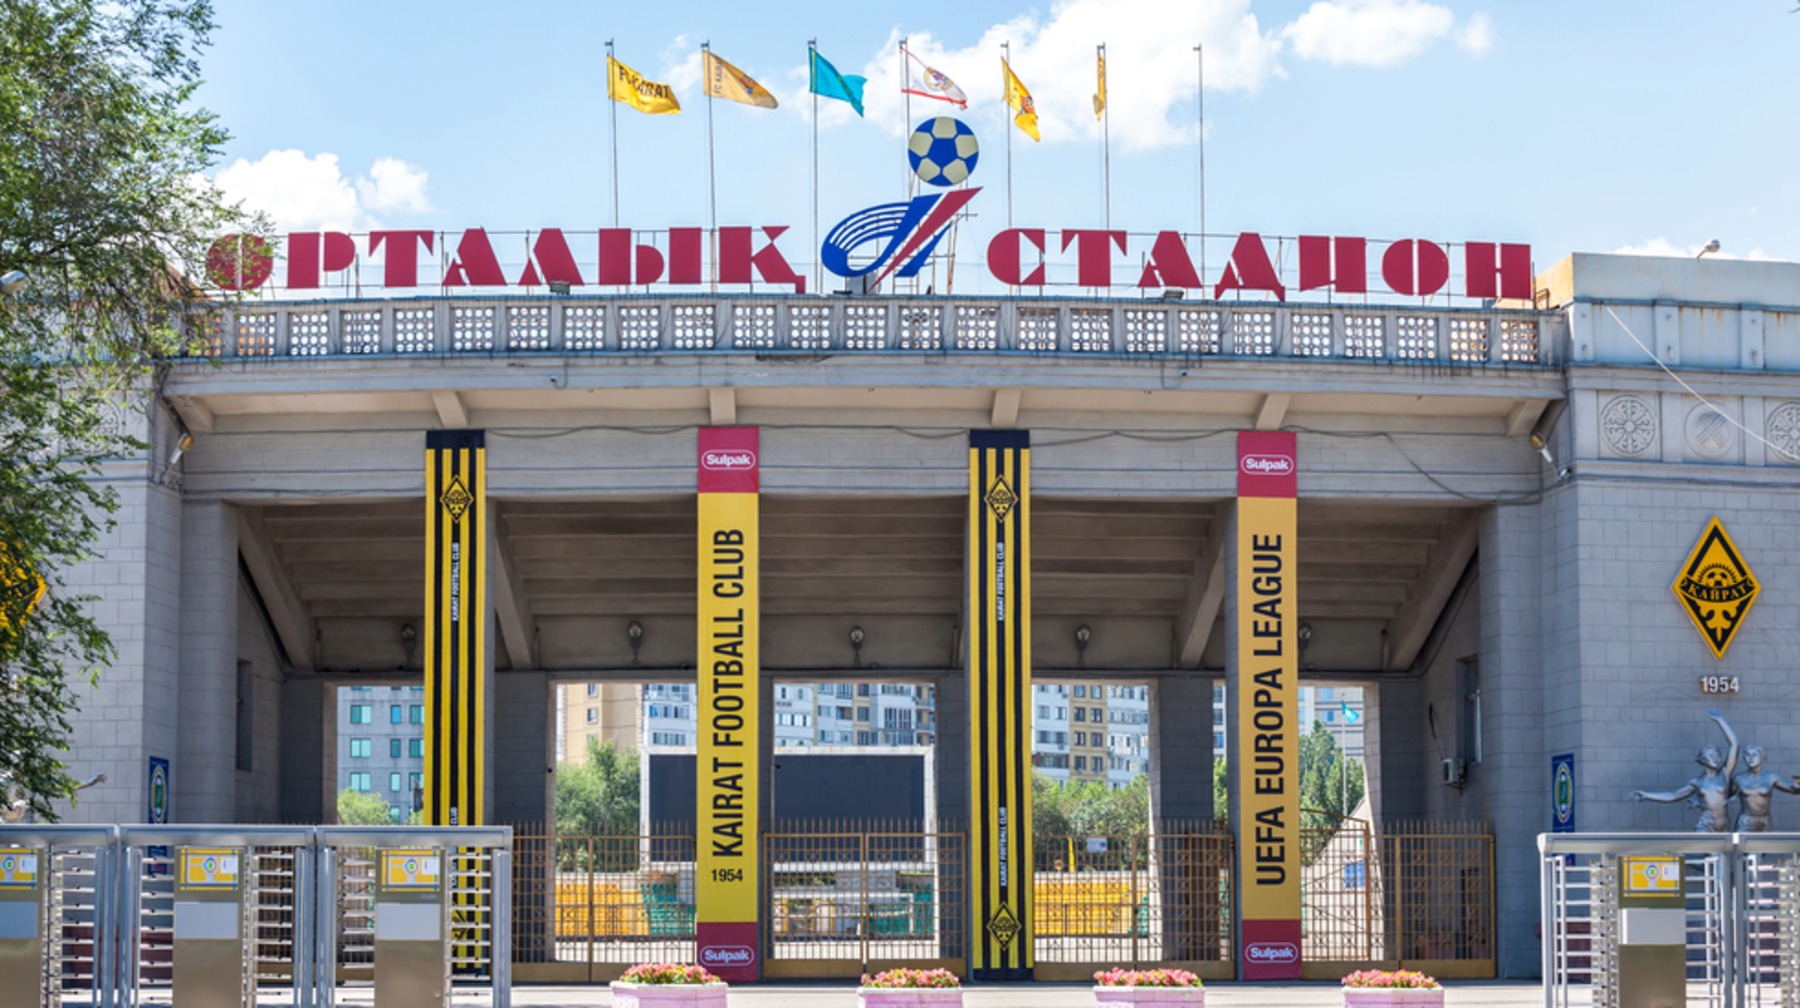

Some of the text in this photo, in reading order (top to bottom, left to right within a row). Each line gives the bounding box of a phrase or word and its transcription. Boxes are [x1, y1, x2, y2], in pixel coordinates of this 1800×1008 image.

[206, 226, 1531, 302] ОРТАЛЫҚ СТАДИОН
[706, 454, 751, 468] Sulpak
[1246, 458, 1289, 472] Sulpak
[451, 542, 459, 560] CLUB
[996, 542, 1005, 560] CLUB
[451, 561, 459, 595] FOOTBALL
[996, 561, 1005, 595] FOOTBALL
[713, 530, 744, 857] KAIRAT FOOTBALL CLUB
[1700, 676, 1739, 693] 1954
[1253, 535, 1286, 886] UEFA EUROPA LEAGUE
[450, 806, 458, 824] CLUB
[998, 806, 1007, 824] CLUB
[999, 825, 1007, 860] FOOTBALL
[711, 868, 743, 882] 1954
[704, 949, 749, 963] Sulpak
[1250, 947, 1293, 961] Sulpak
